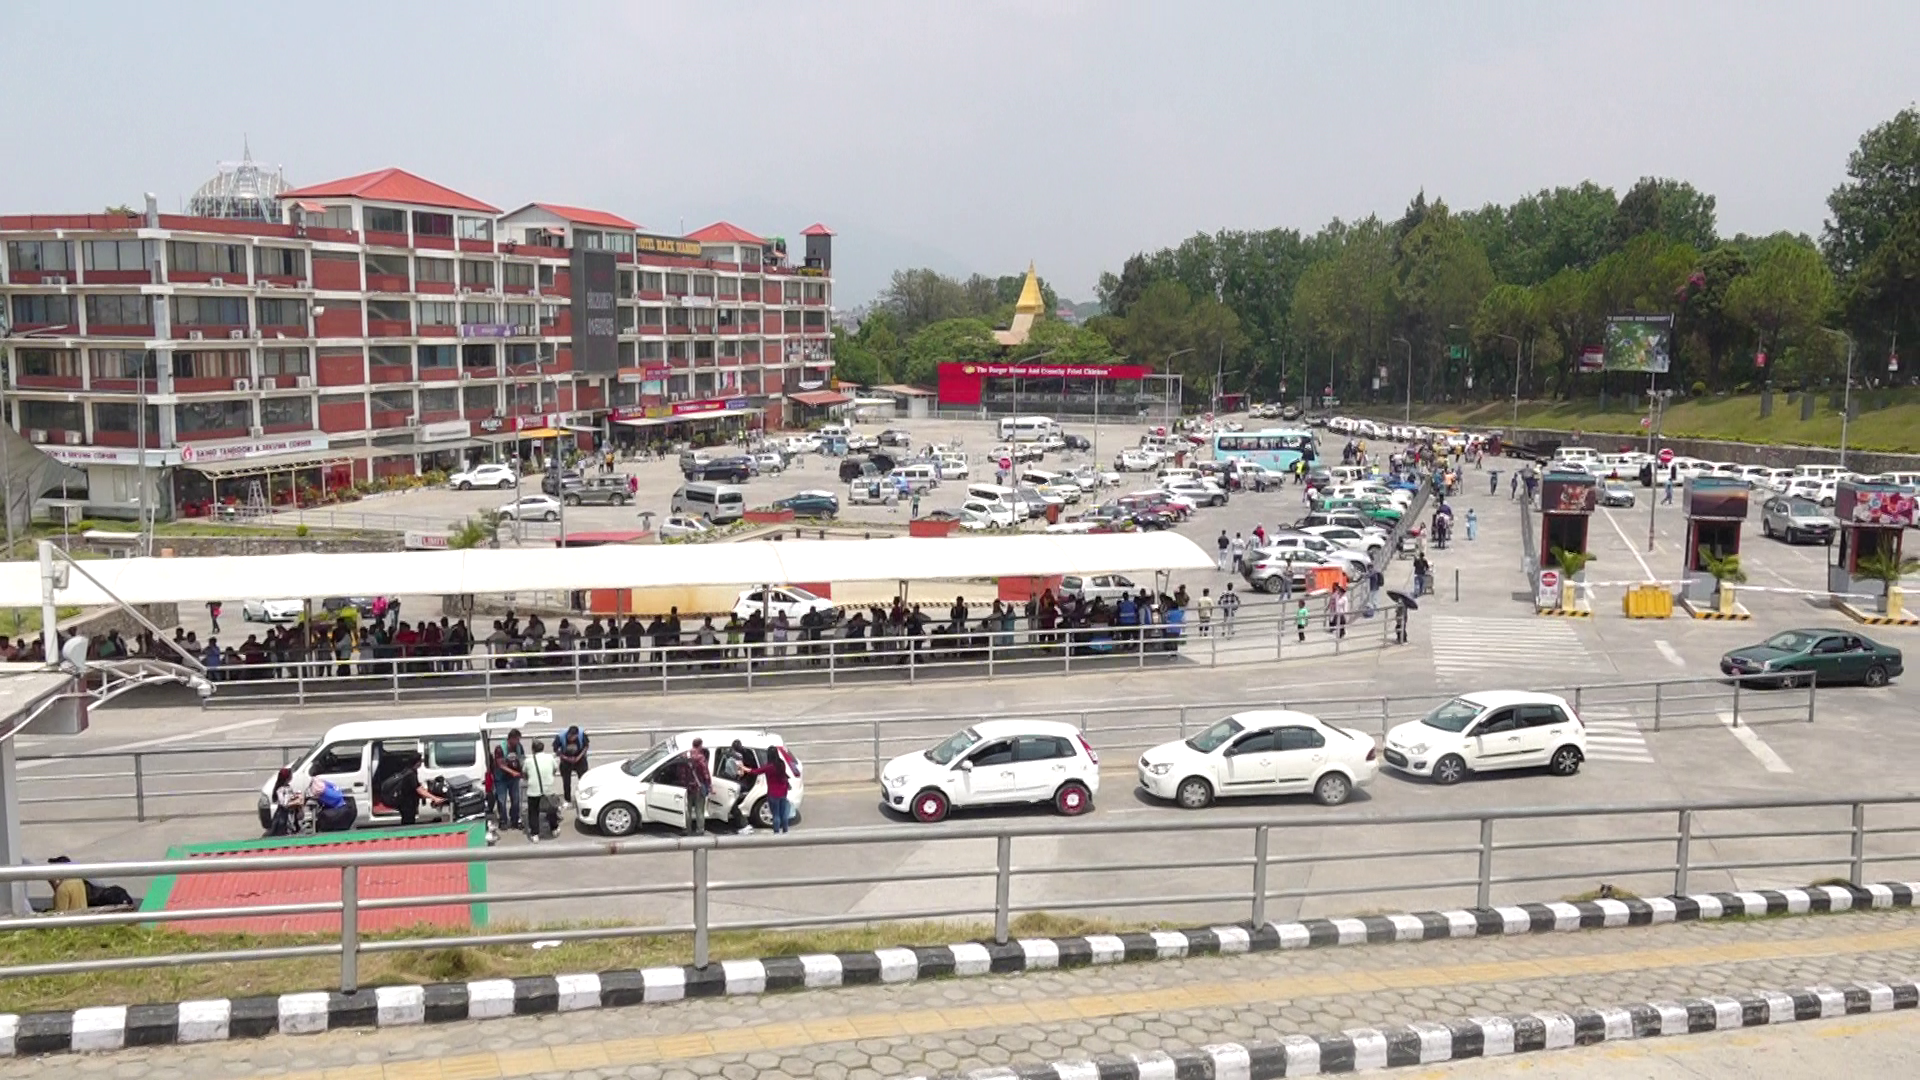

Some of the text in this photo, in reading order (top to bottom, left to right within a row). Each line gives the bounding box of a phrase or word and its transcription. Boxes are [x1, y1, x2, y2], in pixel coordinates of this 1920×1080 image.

[656, 239, 675, 252] BLACK
[676, 242, 701, 255] DIAMOND
[989, 366, 1008, 375] Burger
[1009, 366, 1027, 374] House
